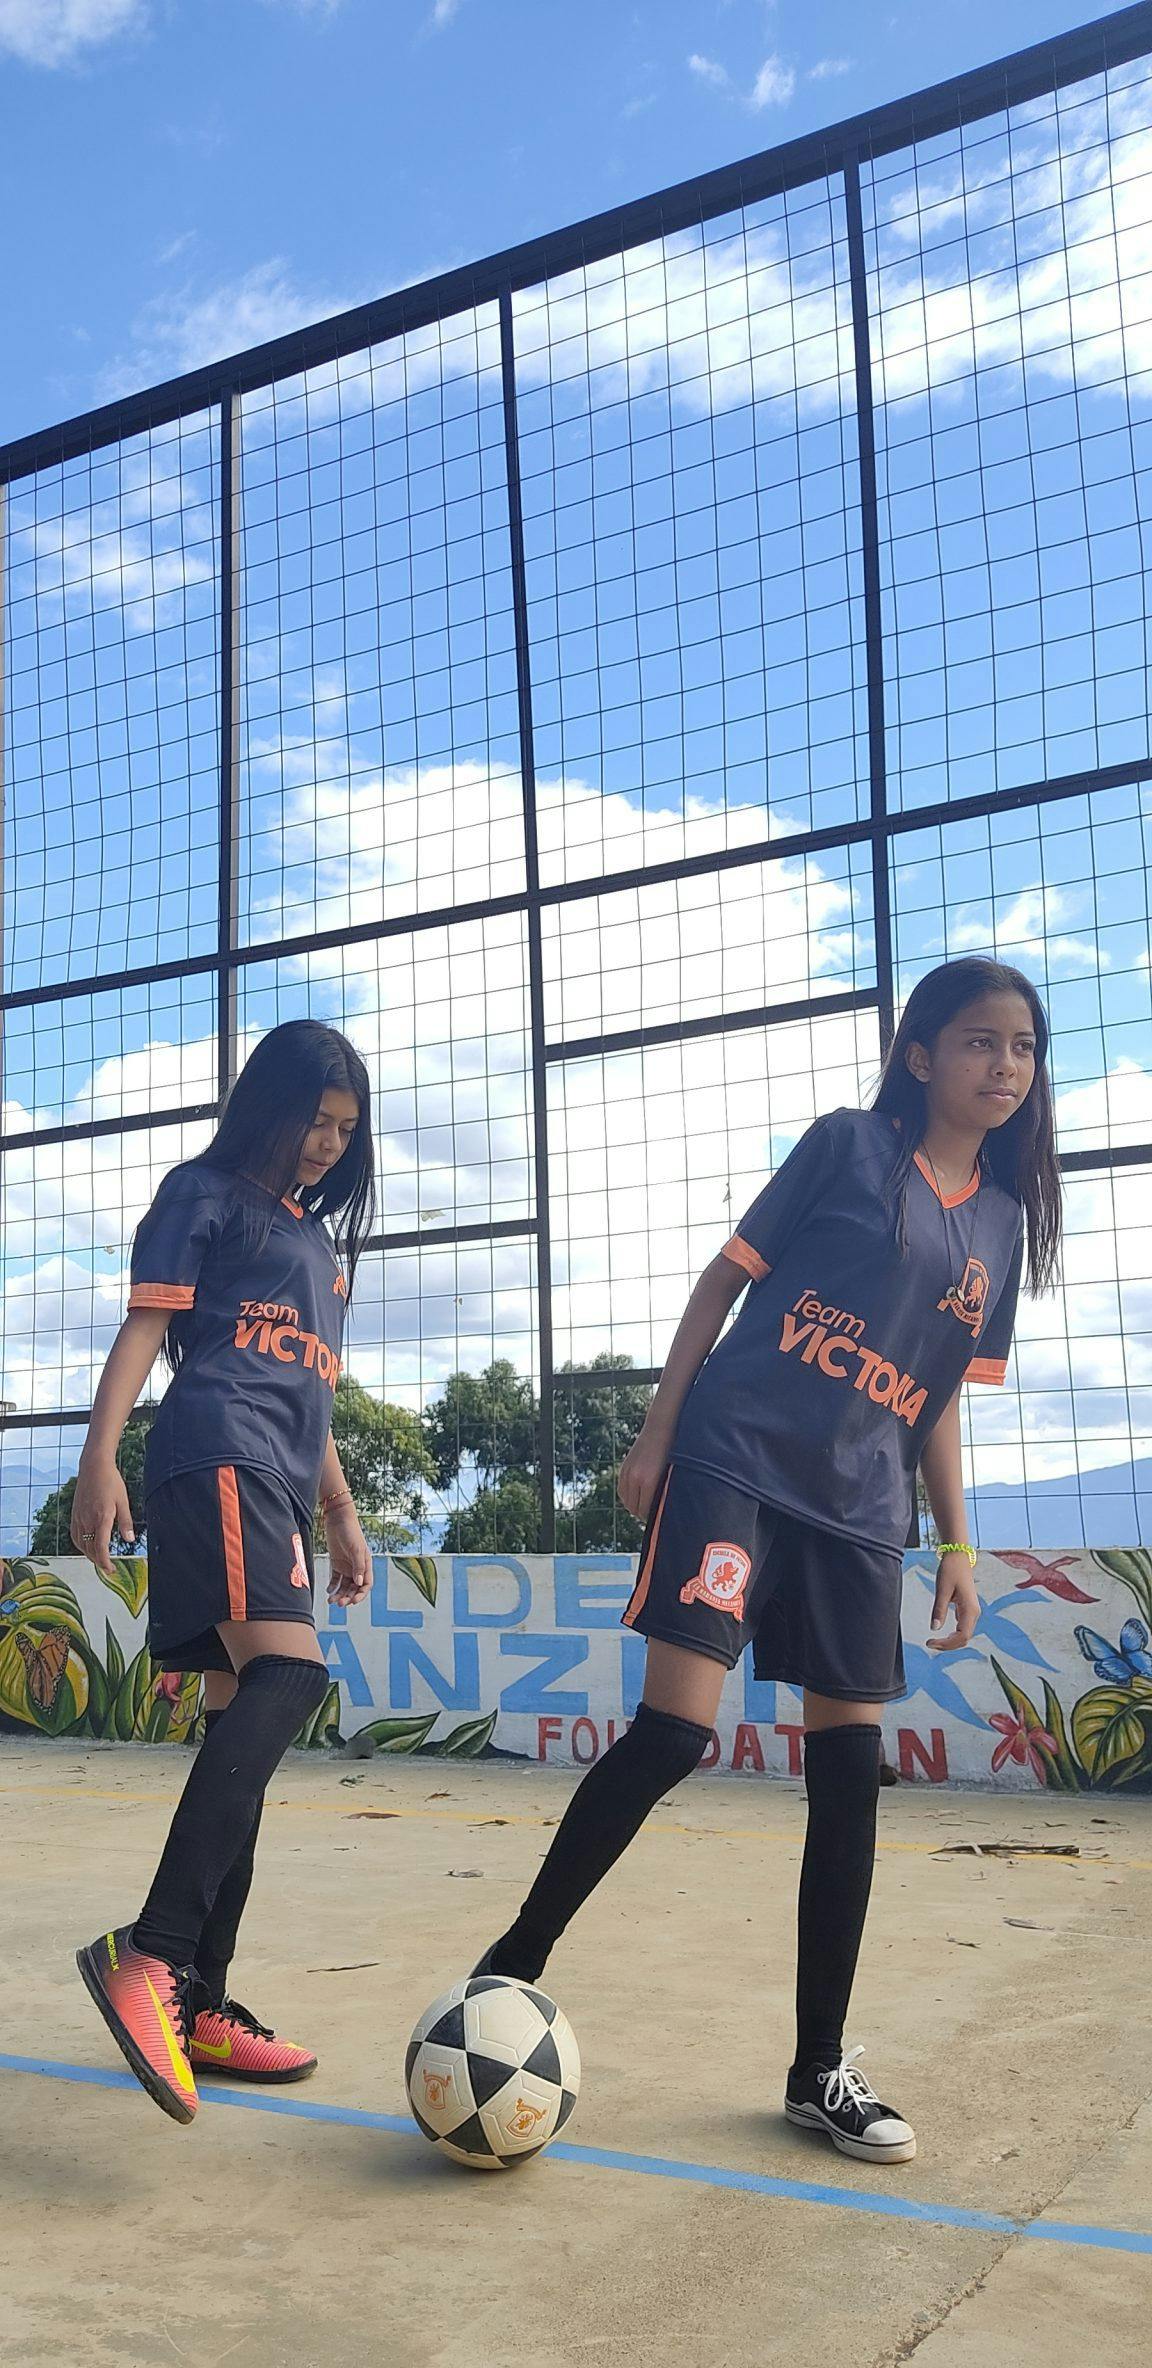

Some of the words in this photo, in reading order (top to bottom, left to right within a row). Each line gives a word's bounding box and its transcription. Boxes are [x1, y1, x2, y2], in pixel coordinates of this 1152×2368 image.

[239, 1299, 299, 1326] Team
[792, 1288, 867, 1339] Team
[234, 1319, 344, 1394] VICTOR
